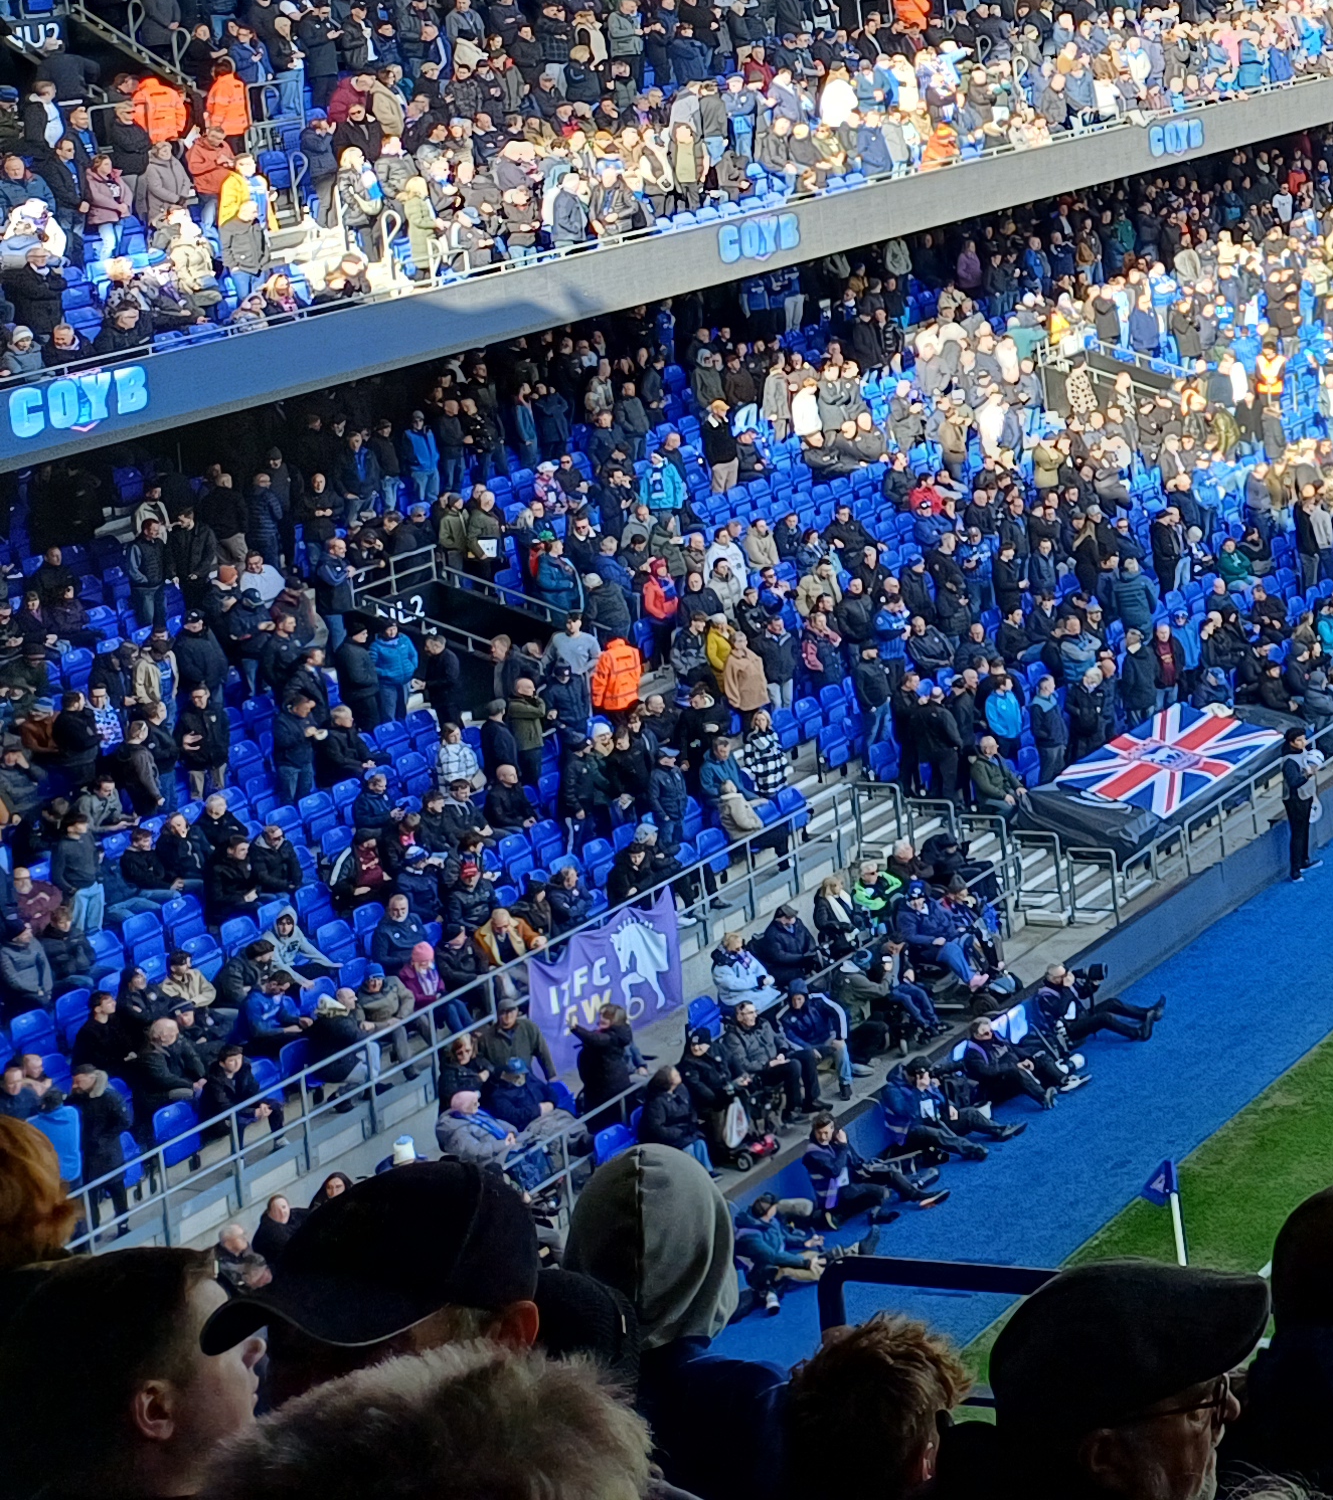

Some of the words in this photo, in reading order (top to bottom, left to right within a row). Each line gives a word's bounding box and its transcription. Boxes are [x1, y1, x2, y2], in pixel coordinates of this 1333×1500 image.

[1149, 118, 1204, 158] COYB
[718, 212, 800, 264] COYB
[8, 365, 148, 438] COYB
[549, 956, 611, 1016] ITFC
